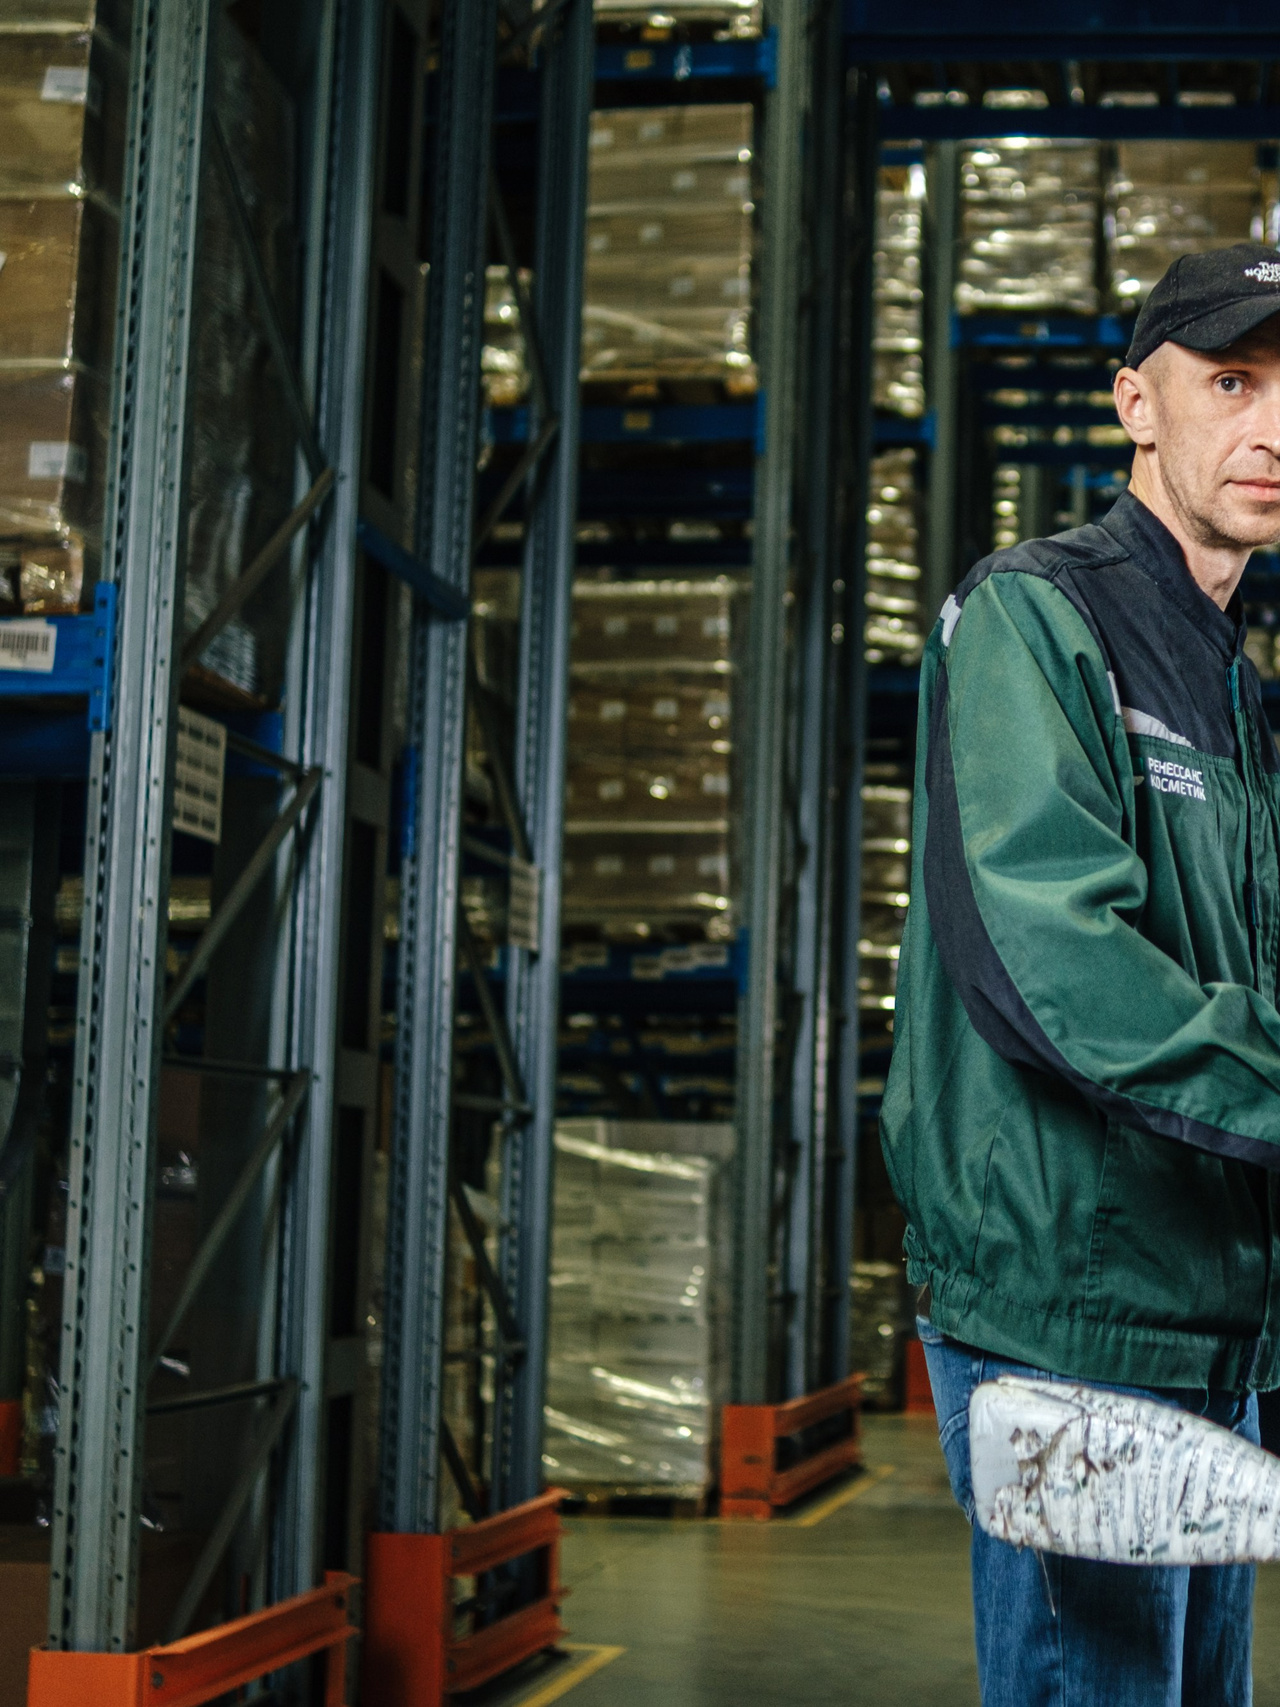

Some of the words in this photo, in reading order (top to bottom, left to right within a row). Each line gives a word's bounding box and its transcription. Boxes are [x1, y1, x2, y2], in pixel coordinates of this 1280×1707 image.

[1258, 261, 1280, 271] THE
[1148, 757, 1203, 785] РЕНЕССАНС
[1150, 774, 1206, 801] КОСМЕТИК
